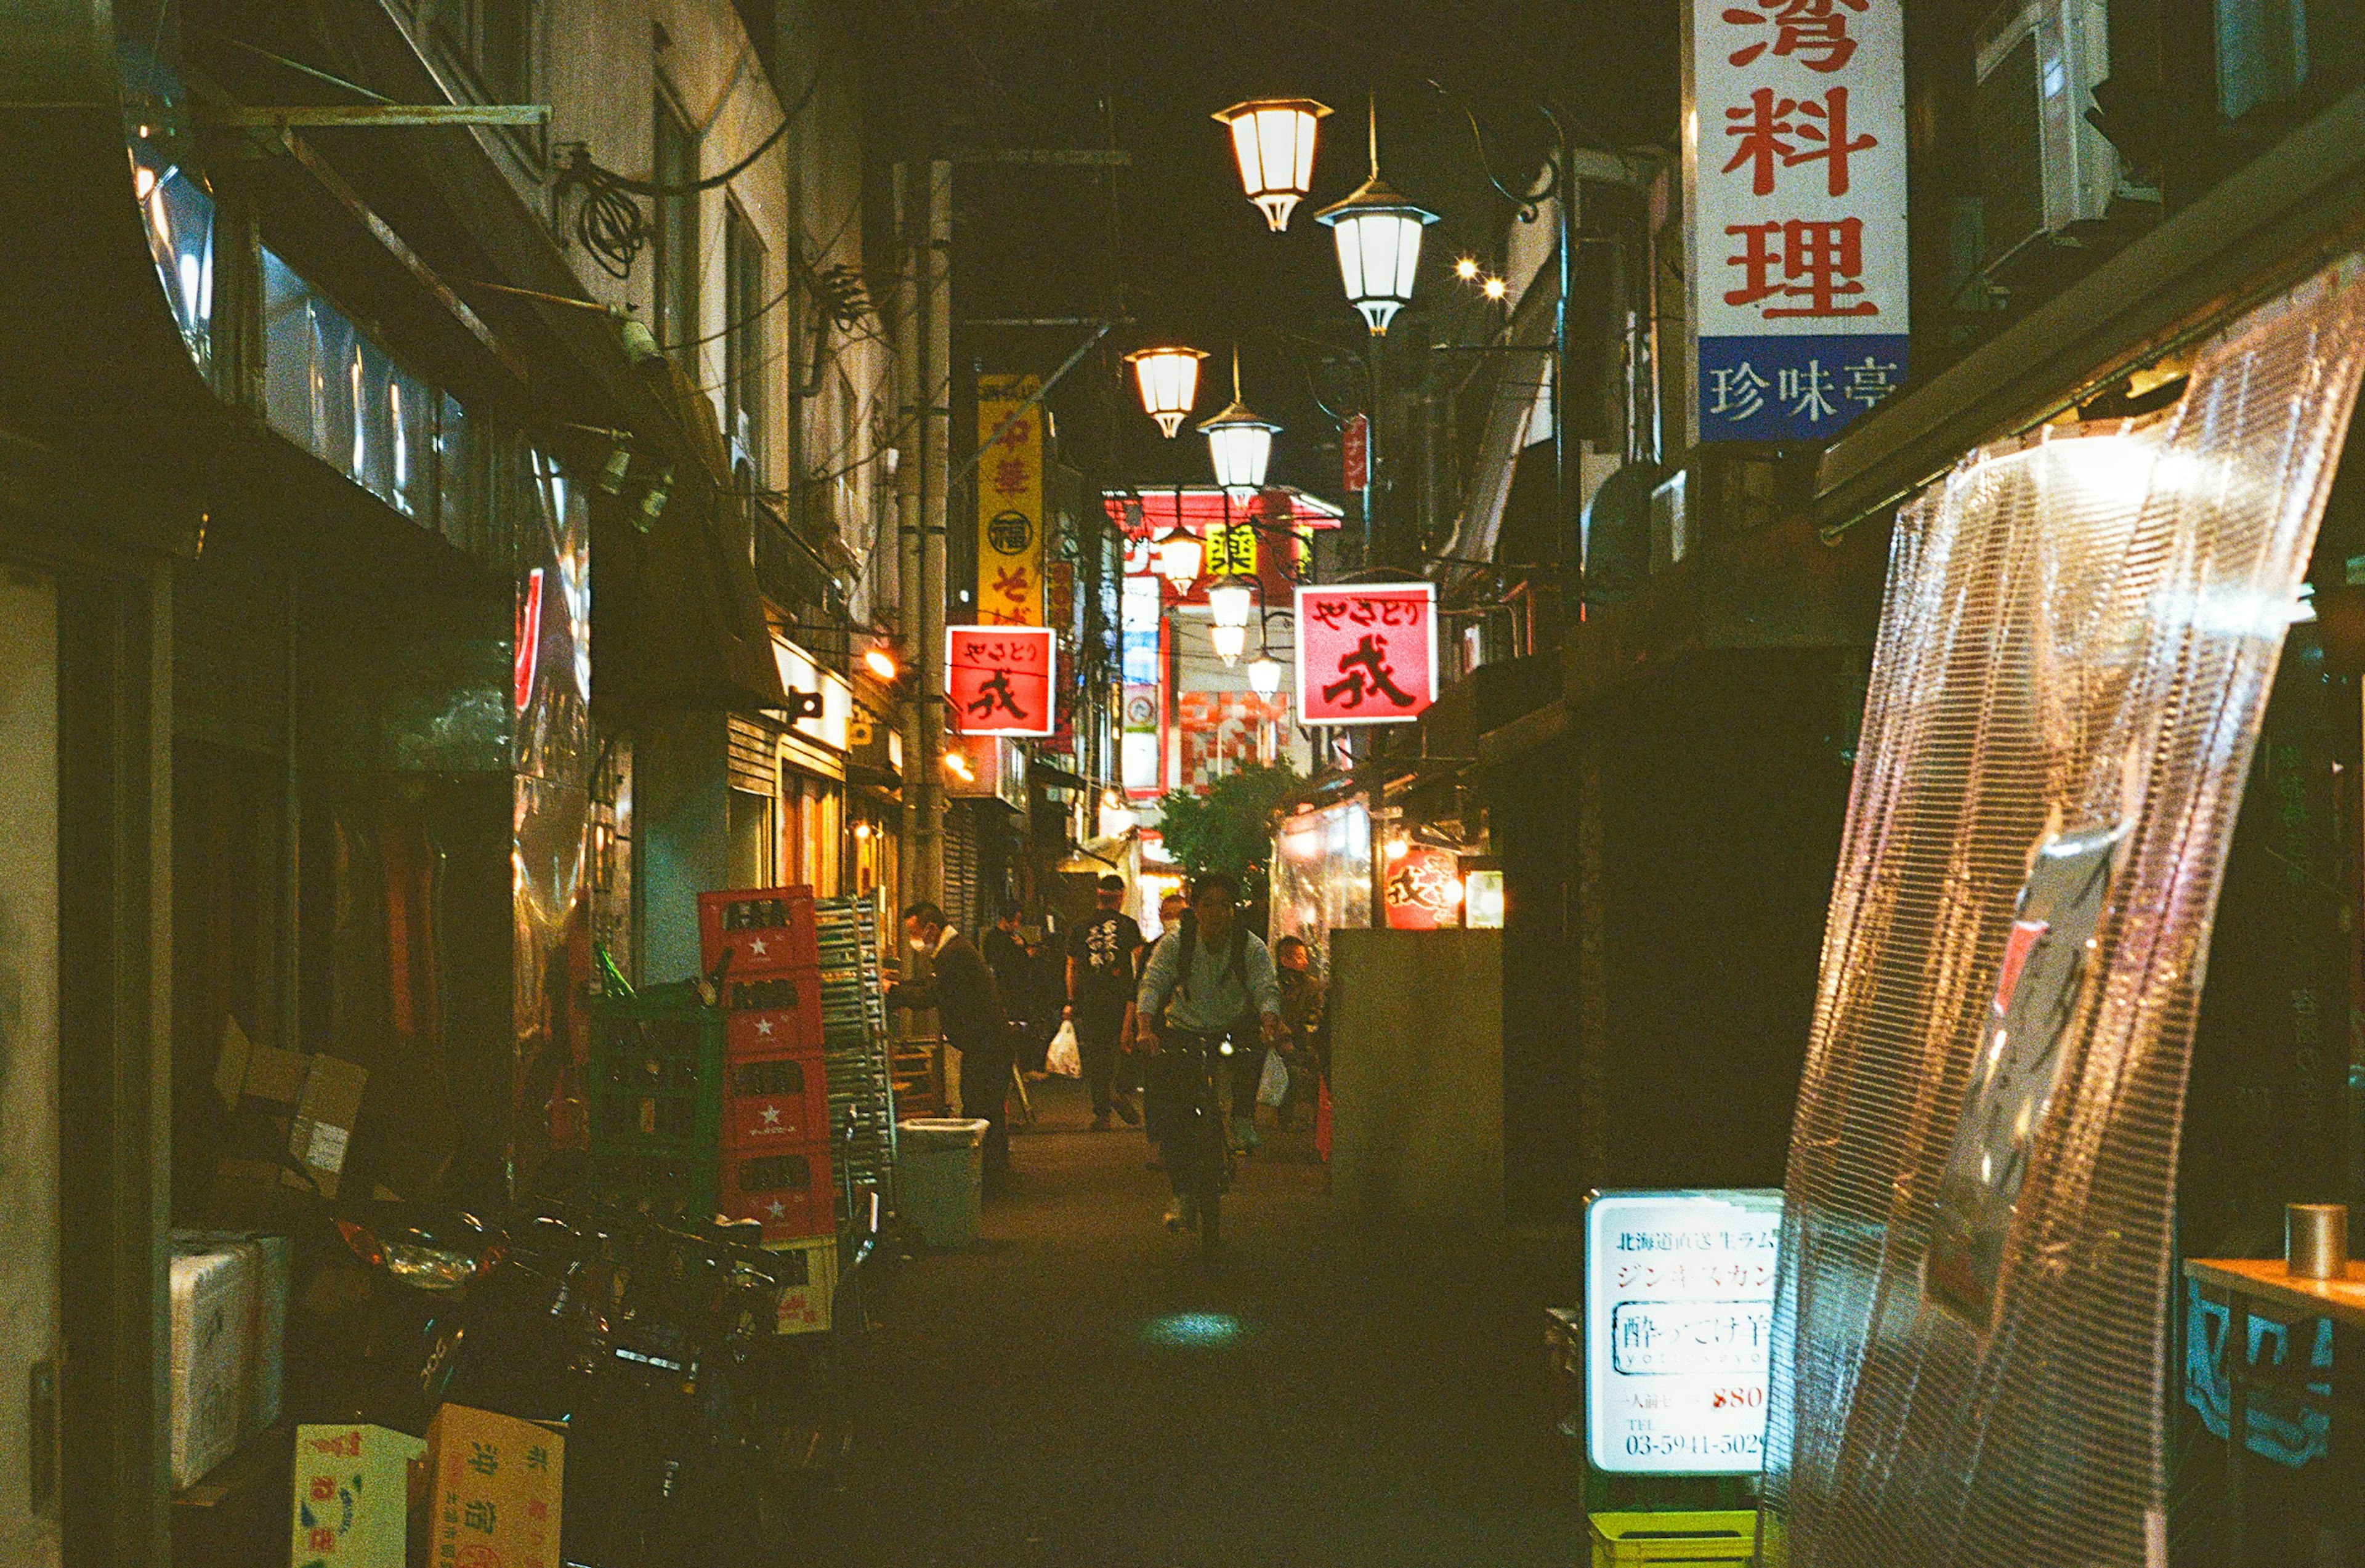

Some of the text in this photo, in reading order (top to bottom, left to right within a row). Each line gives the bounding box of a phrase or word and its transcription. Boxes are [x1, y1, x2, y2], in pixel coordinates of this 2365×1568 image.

[1710, 357, 1898, 422] 珍味亭
[1628, 1419, 1655, 1431] TEL
